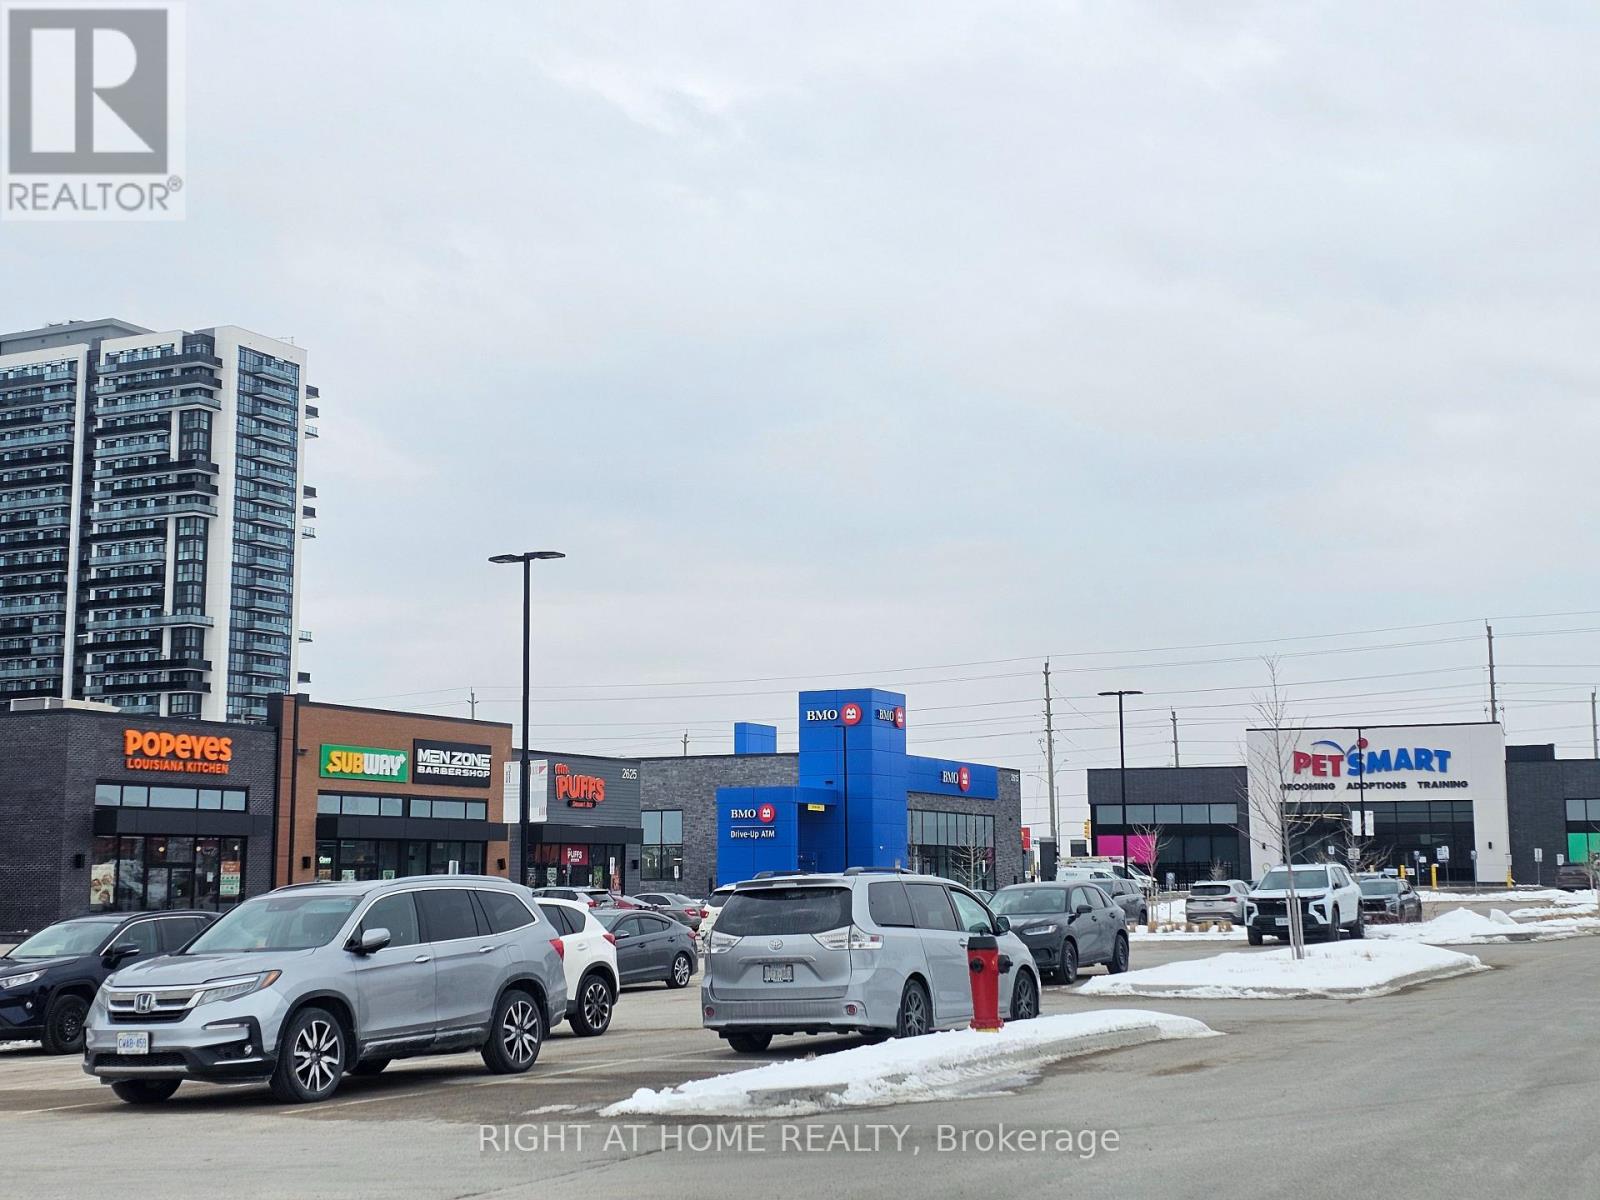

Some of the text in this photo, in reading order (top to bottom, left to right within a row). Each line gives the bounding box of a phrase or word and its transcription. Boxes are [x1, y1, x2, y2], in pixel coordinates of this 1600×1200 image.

[806, 709, 838, 721] BMO
[878, 708, 894, 721] BMO
[127, 758, 229, 774] LOUISIANA KITCHEN
[326, 751, 406, 776] SUBWAY
[417, 766, 490, 777] BARBERSHOP
[621, 768, 638, 780] 2625
[943, 771, 959, 784] BMO
[556, 775, 605, 802] PUFFS
[1280, 780, 1469, 791] GROOMING ADOPTIONS TRAINING
[731, 809, 756, 819] BMO
[731, 829, 775, 839] Drive-Up ATM
[567, 850, 583, 860] PUFFS
